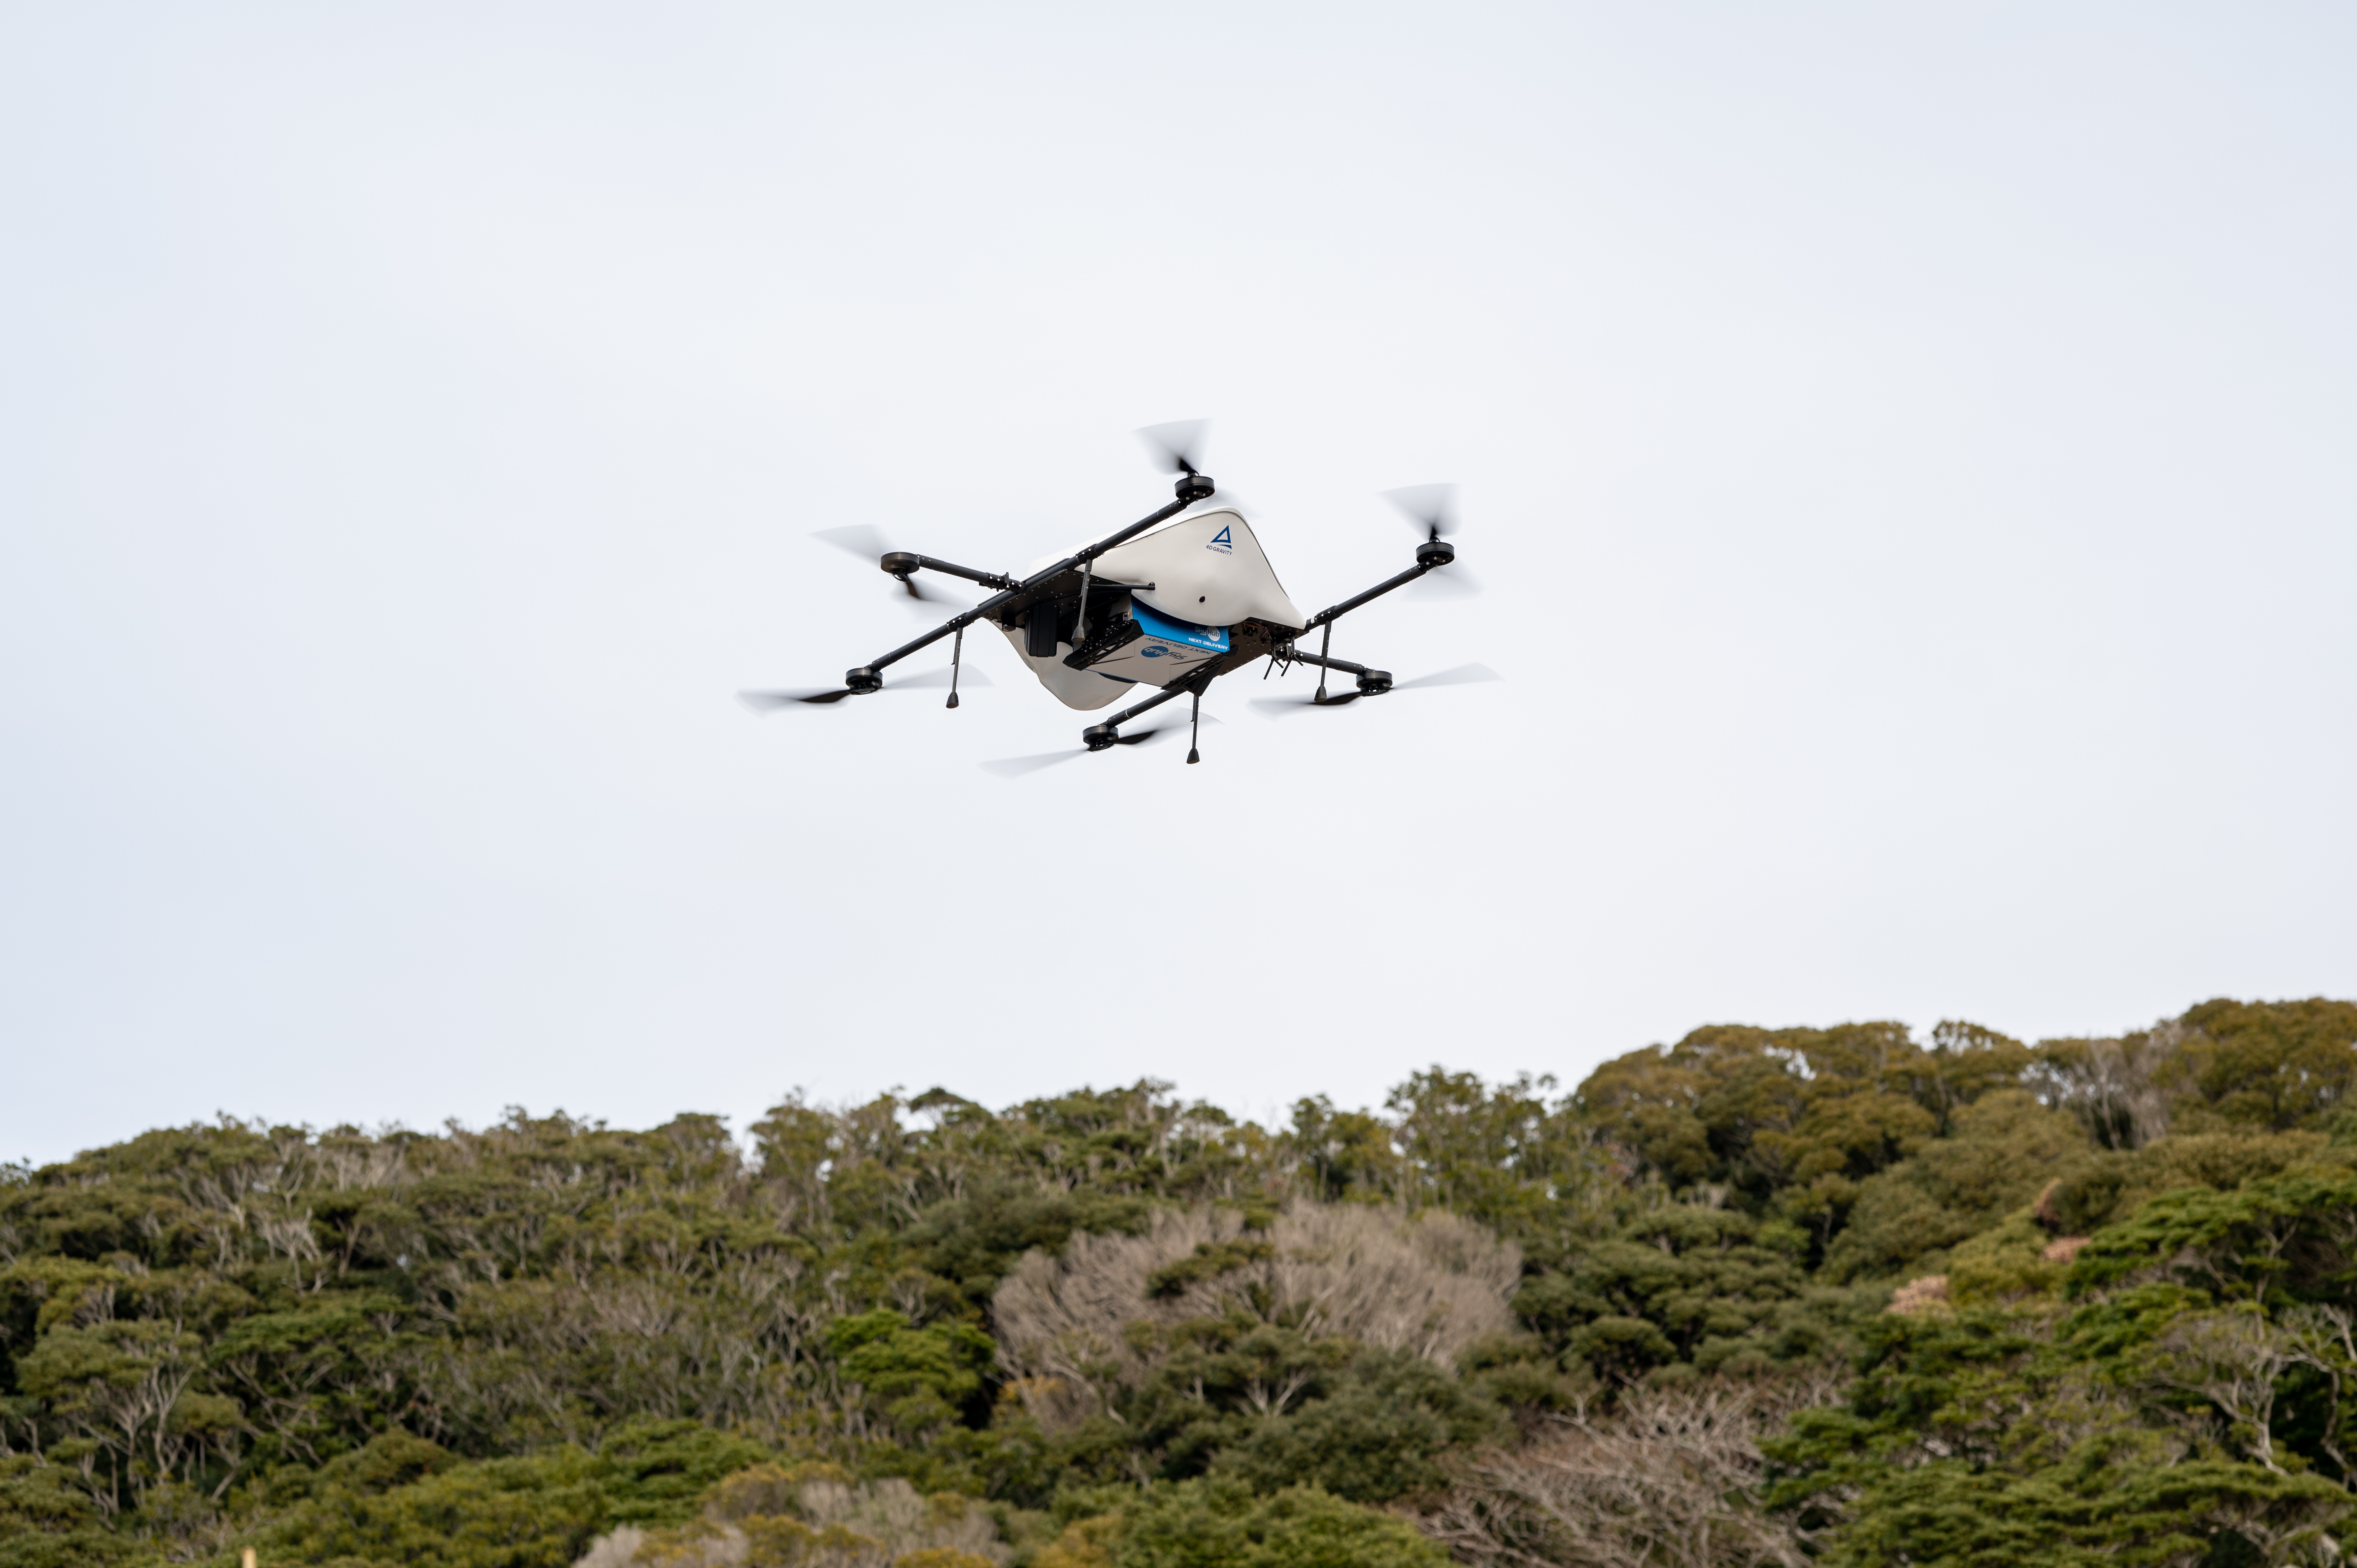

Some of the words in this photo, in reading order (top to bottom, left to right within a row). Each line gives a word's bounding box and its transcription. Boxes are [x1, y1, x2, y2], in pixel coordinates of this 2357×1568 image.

[1213, 547, 1232, 556] GRAVITY
[1145, 637, 1188, 649] DELIVERY
[1203, 641, 1228, 650] DELIVERY
